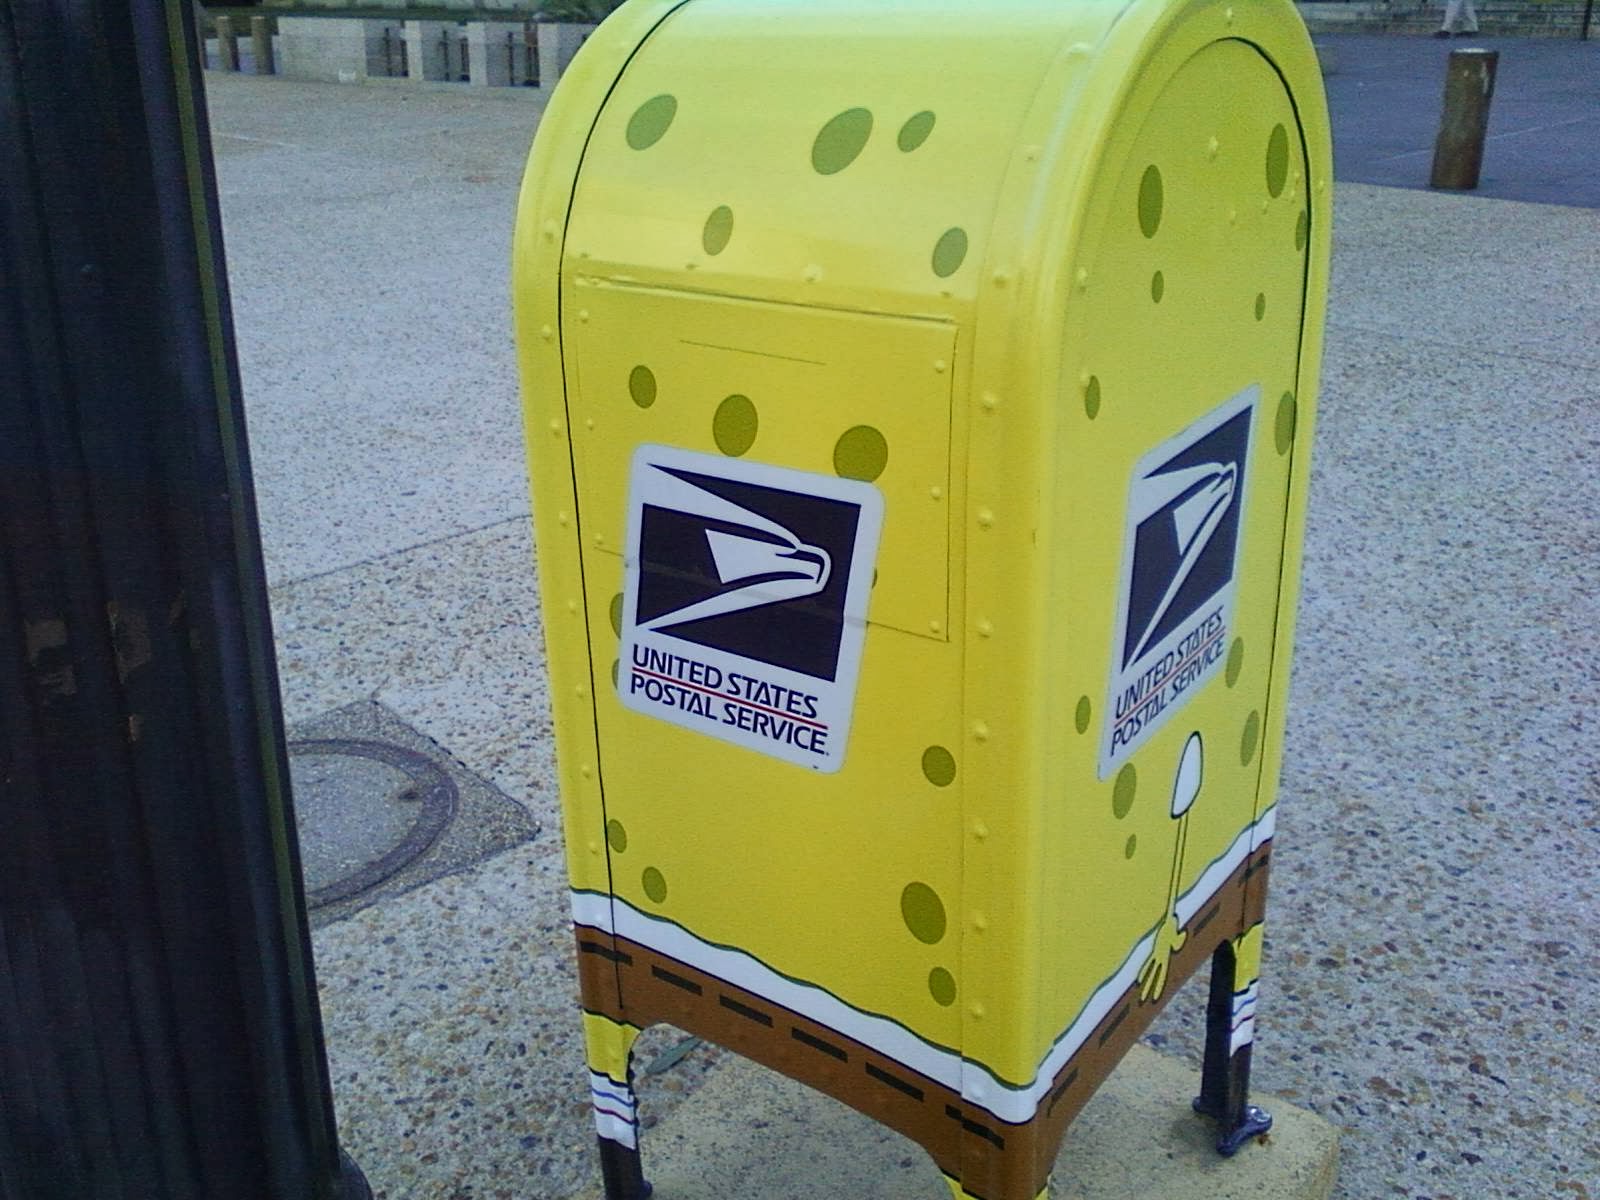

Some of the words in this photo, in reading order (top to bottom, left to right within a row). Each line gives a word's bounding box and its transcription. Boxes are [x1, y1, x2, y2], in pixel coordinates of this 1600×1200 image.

[633, 643, 722, 689] UNITED
[727, 673, 818, 719] STATES
[1110, 687, 1168, 758] POSTAL
[1170, 632, 1226, 702] SERVICE
[1116, 651, 1175, 719] UNITED
[1176, 604, 1225, 667] STATES
[630, 673, 718, 720] POSTAL
[722, 702, 828, 755] SERVICE
